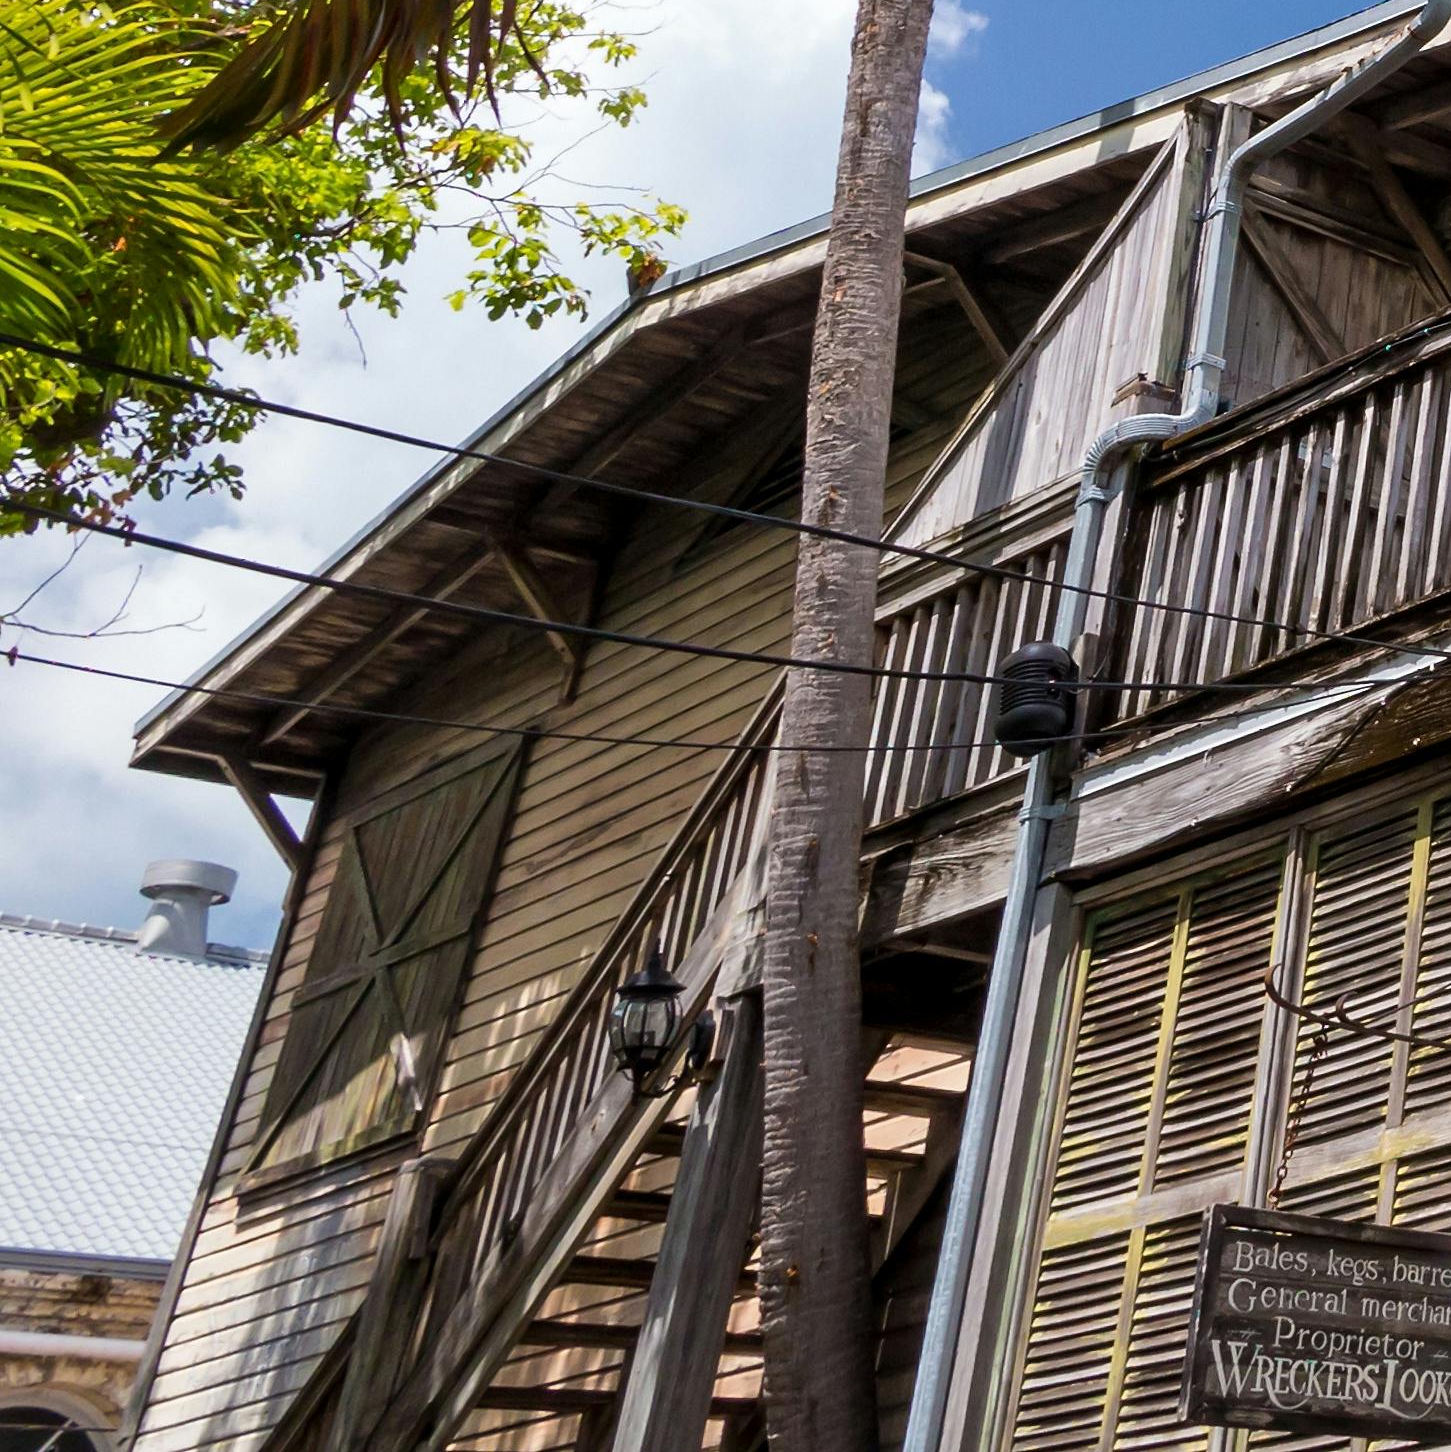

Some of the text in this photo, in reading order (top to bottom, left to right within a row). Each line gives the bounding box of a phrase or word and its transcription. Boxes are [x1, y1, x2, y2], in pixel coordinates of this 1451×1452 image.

[1232, 1241, 1316, 1277] Bales,
[1326, 1249, 1387, 1286] kegs,
[1228, 1277, 1347, 1316] General
[1272, 1316, 1425, 1360] Proprietor
